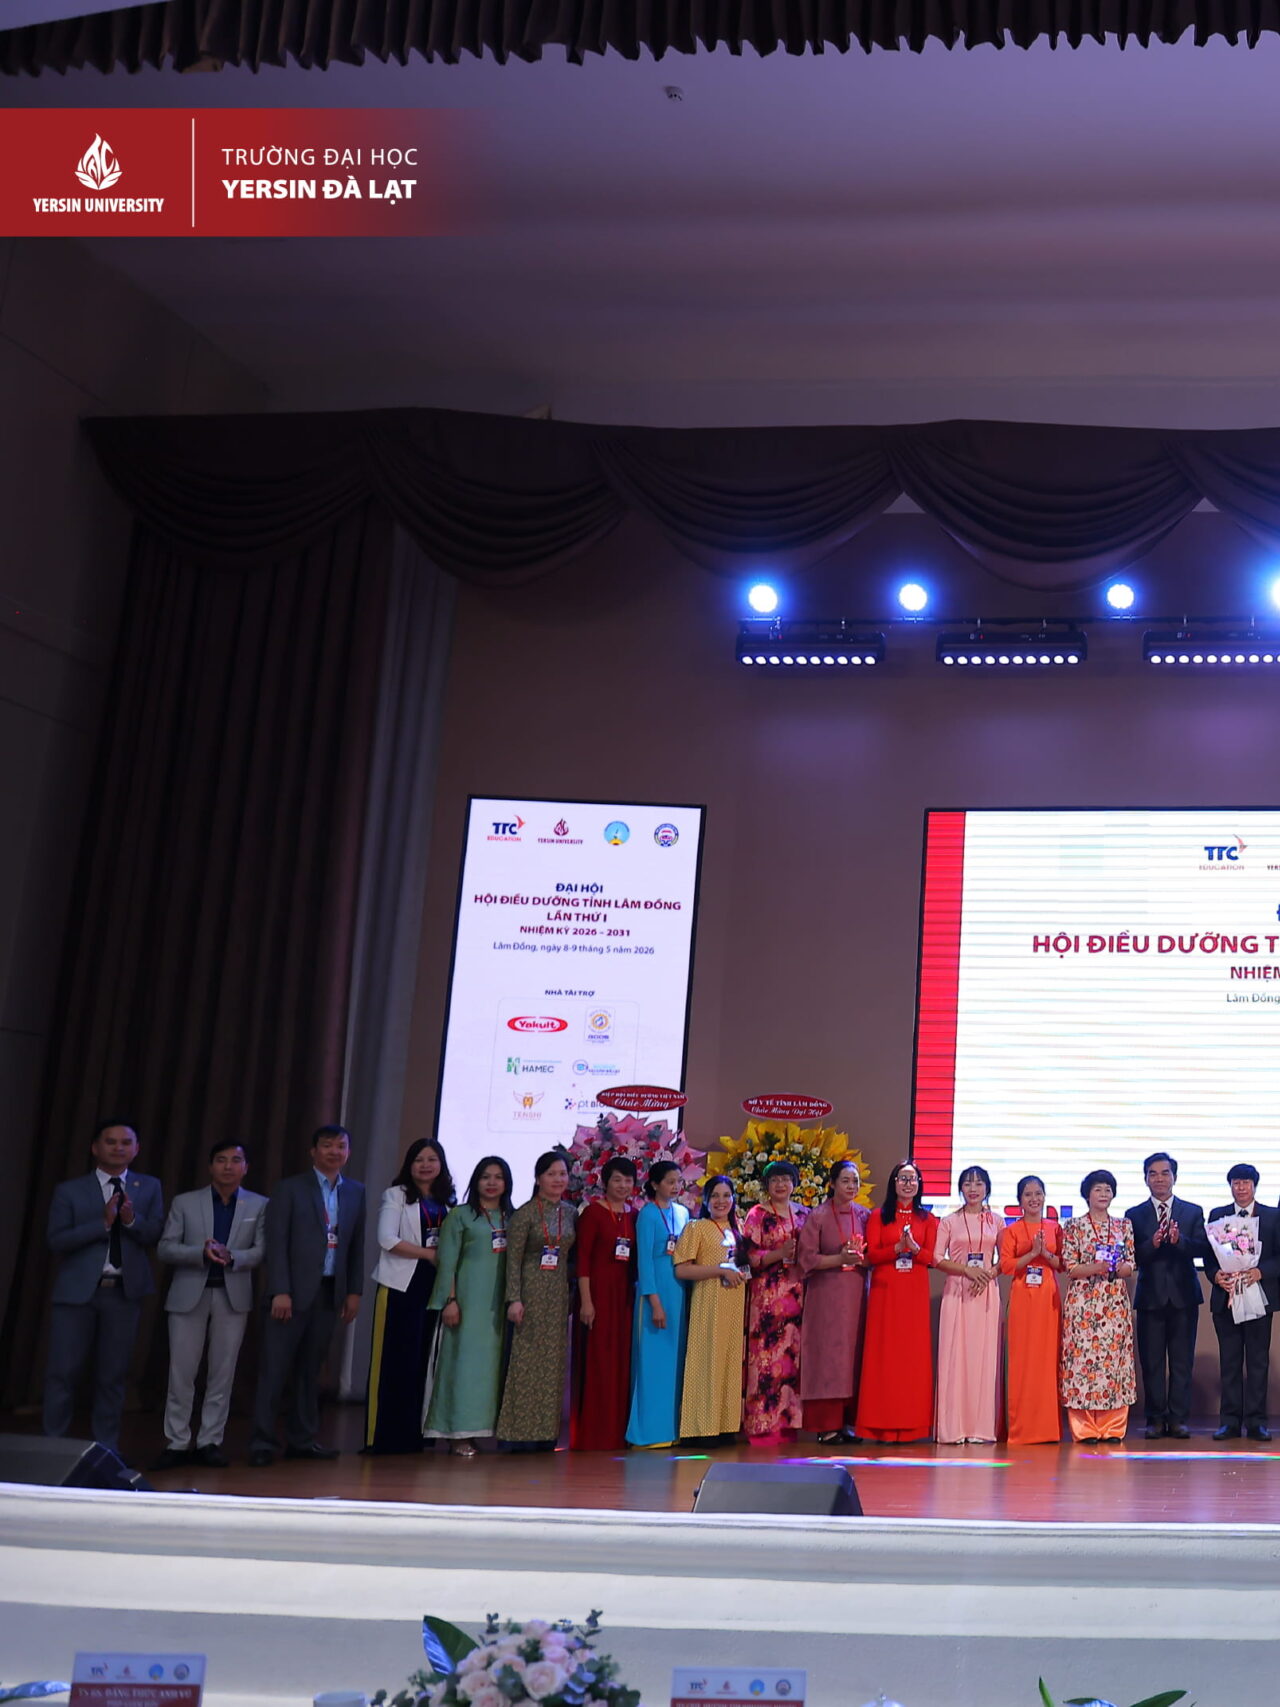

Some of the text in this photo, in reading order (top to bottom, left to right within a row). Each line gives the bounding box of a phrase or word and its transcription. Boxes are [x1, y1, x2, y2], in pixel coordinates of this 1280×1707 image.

[492, 822, 517, 835] TTC
[1204, 846, 1239, 861] TTC
[556, 882, 603, 895] ĐẠI HỘI
[1032, 932, 1080, 959] HỘI
[1087, 930, 1150, 954] ĐIỀU
[1157, 932, 1259, 954] DƯỠNG
[1226, 993, 1249, 1003] Lâm
[519, 1020, 556, 1029] Yakult
[522, 1065, 554, 1073] HAMEC
